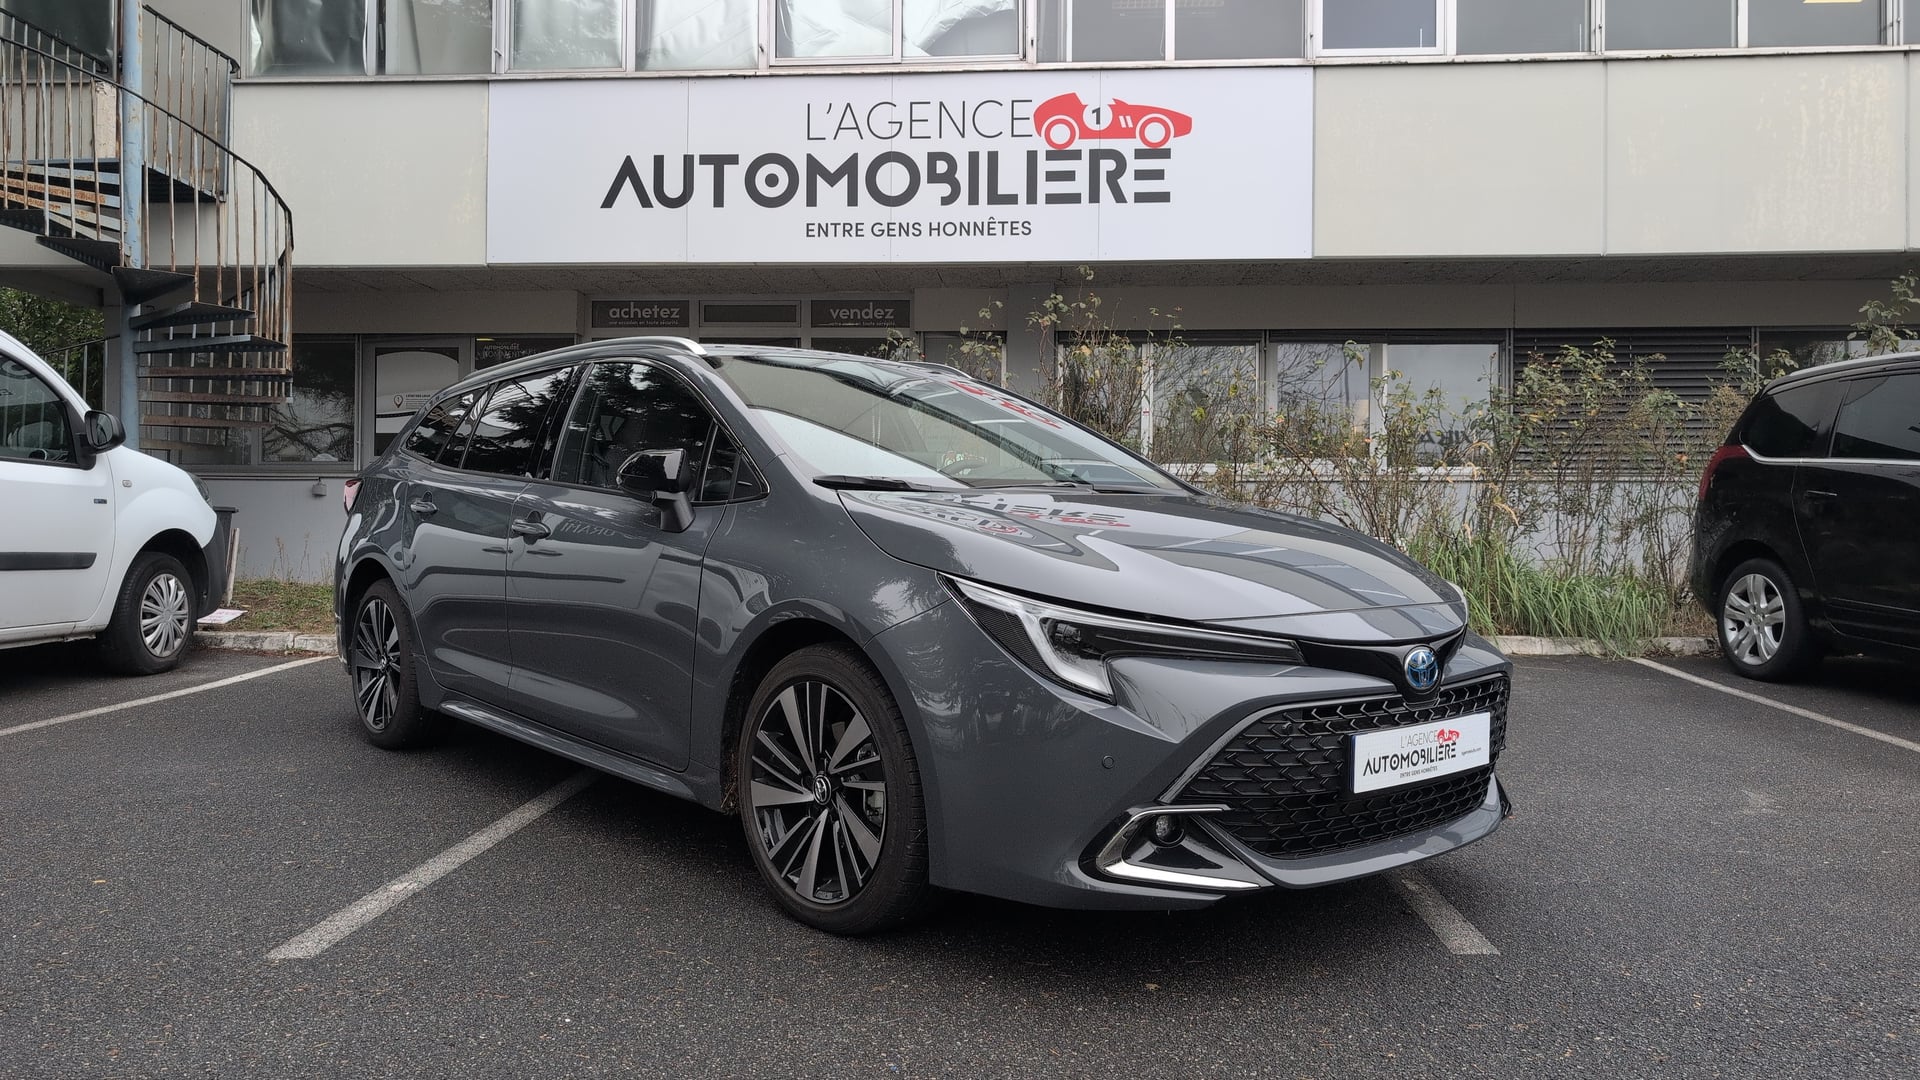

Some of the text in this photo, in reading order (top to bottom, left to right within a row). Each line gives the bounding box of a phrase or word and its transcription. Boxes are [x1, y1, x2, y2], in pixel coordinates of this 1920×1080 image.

[806, 100, 1032, 140] L'AGENCE
[806, 216, 1032, 238] ENTRE GENS HONNÊTES
[609, 302, 680, 318] achetez
[831, 302, 894, 318] vendez
[1400, 730, 1438, 749] L'AGENCE
